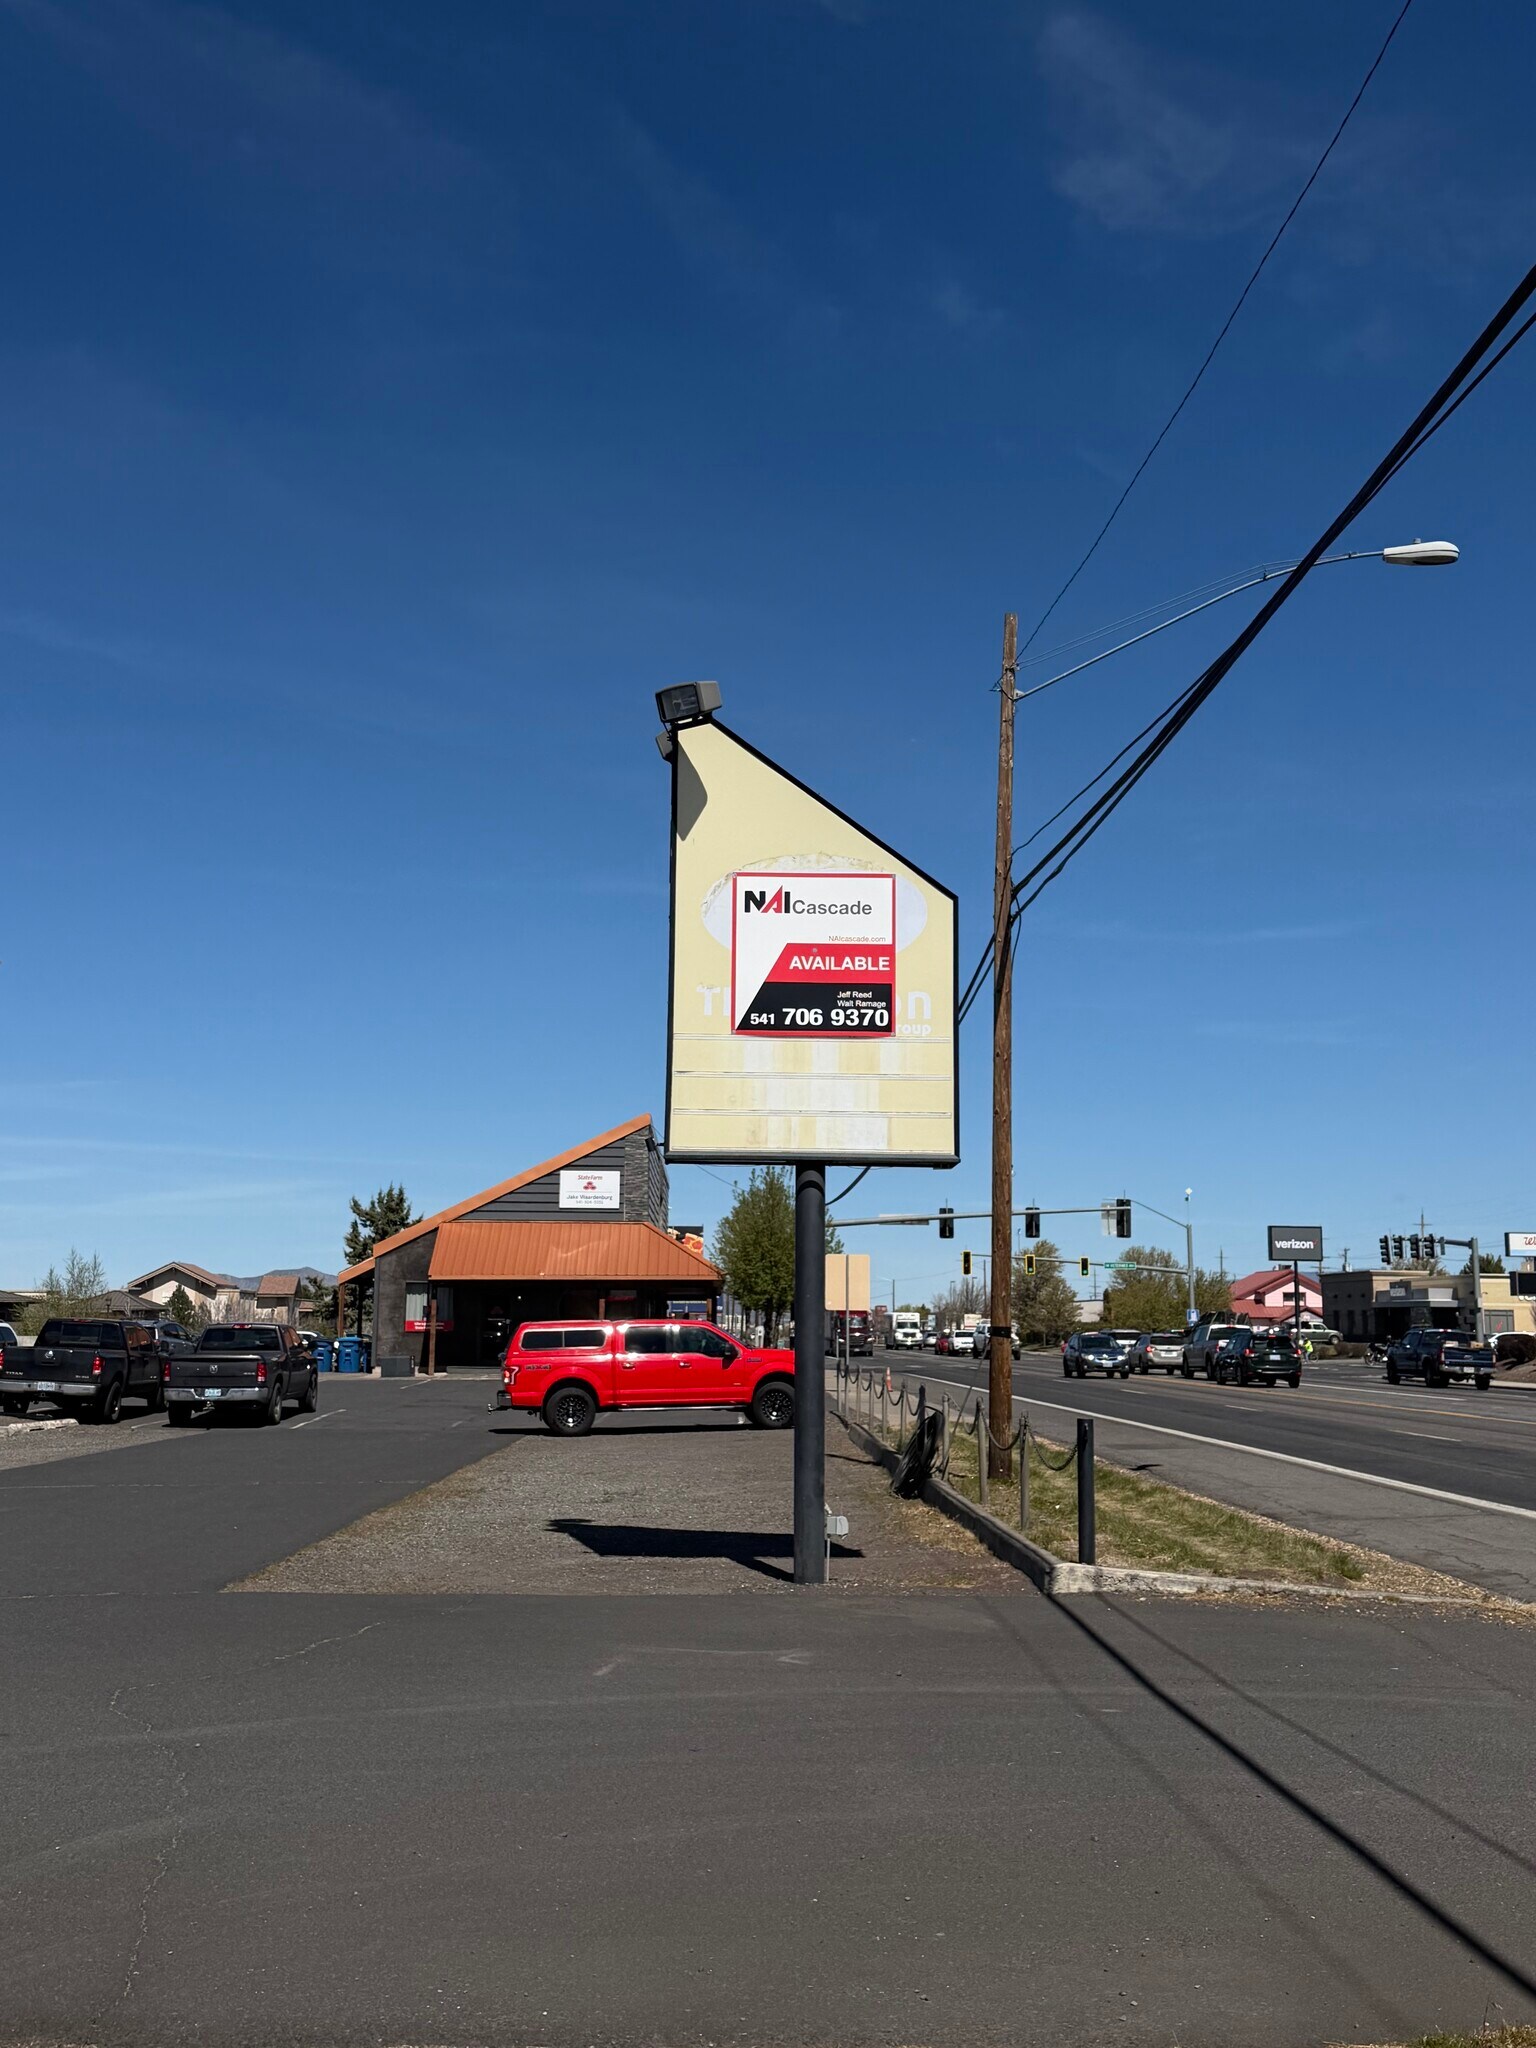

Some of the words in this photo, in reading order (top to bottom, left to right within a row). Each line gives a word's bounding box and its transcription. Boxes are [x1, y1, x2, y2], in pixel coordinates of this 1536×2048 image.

[744, 885, 791, 914] NAI
[792, 899, 873, 915] Cascade
[789, 956, 890, 971] AVAILABLE
[837, 1000, 853, 1008] Walt
[855, 1000, 886, 1009] Ramage
[750, 1012, 775, 1025] 541
[782, 1008, 823, 1026] 706
[830, 1009, 889, 1027] 9370
[1274, 1239, 1314, 1249] verizon
